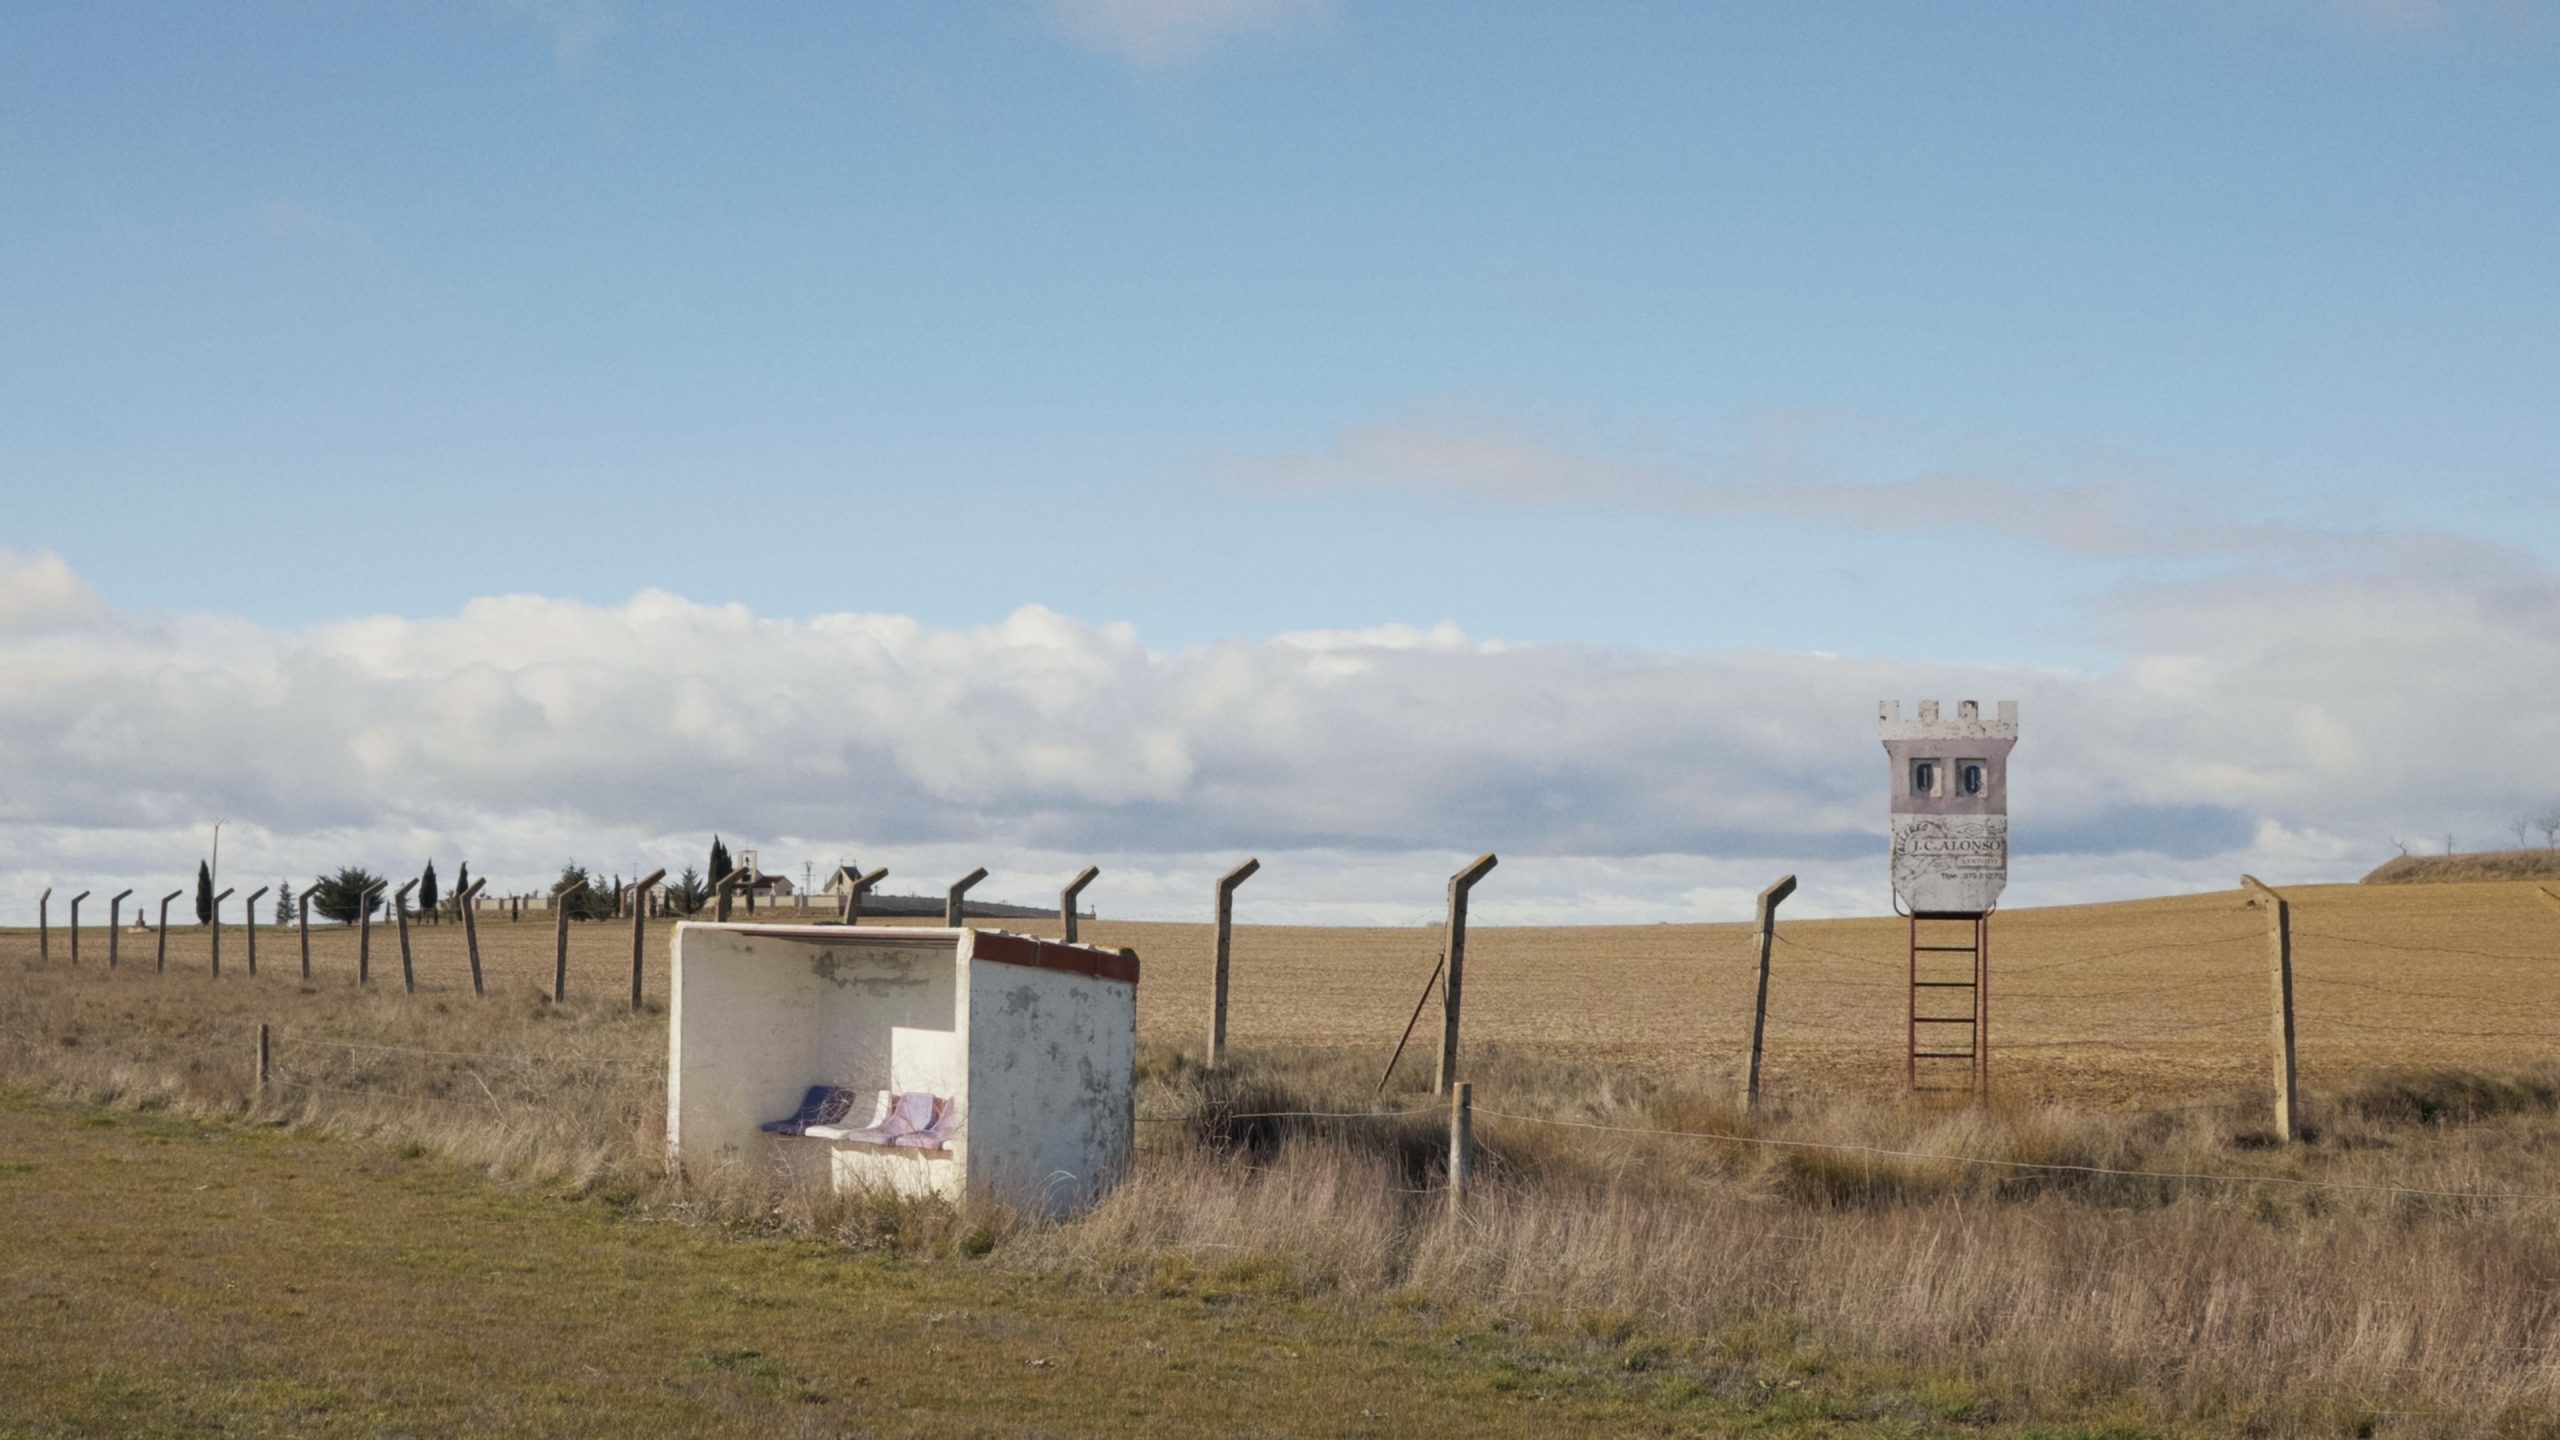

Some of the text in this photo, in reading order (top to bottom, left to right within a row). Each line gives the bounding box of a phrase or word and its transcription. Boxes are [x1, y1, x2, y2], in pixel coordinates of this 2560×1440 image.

[1917, 763, 1982, 794] 0 0
[1939, 840, 2001, 851] ALONSO
